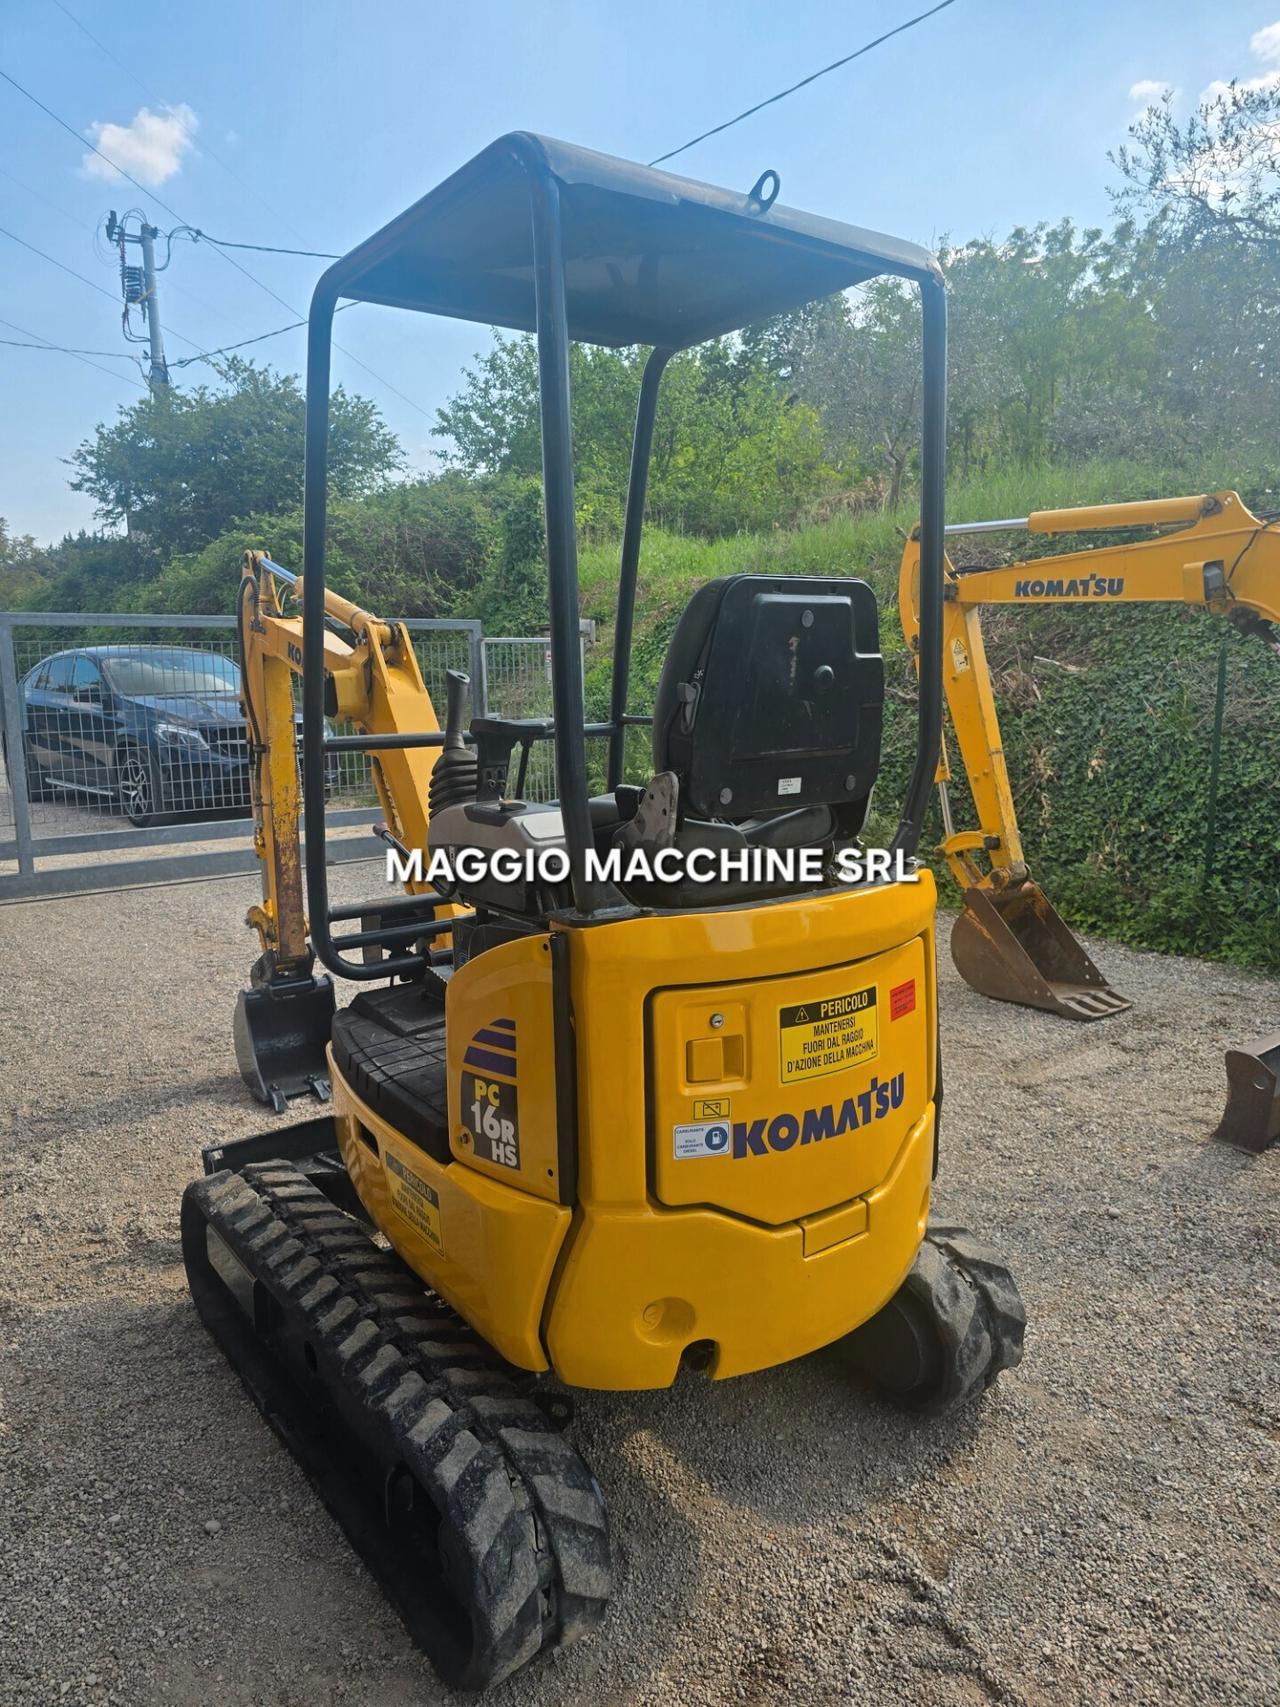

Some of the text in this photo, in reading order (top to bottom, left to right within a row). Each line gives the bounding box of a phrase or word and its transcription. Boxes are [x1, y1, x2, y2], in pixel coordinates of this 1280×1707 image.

[1015, 574, 1124, 597] KOMATSU
[287, 641, 304, 667] KO
[820, 992, 868, 1018] PERICOLO
[813, 1016, 856, 1037] MANTENERSI
[803, 1028, 864, 1055] FUORI DAL RAGGIO
[787, 1039, 874, 1073] D'AZIONE DELLA MACCHINA
[475, 1079, 500, 1107] PC
[471, 1101, 517, 1146] 16R
[733, 1072, 905, 1159] KOMATSU
[491, 1140, 518, 1167] HS
